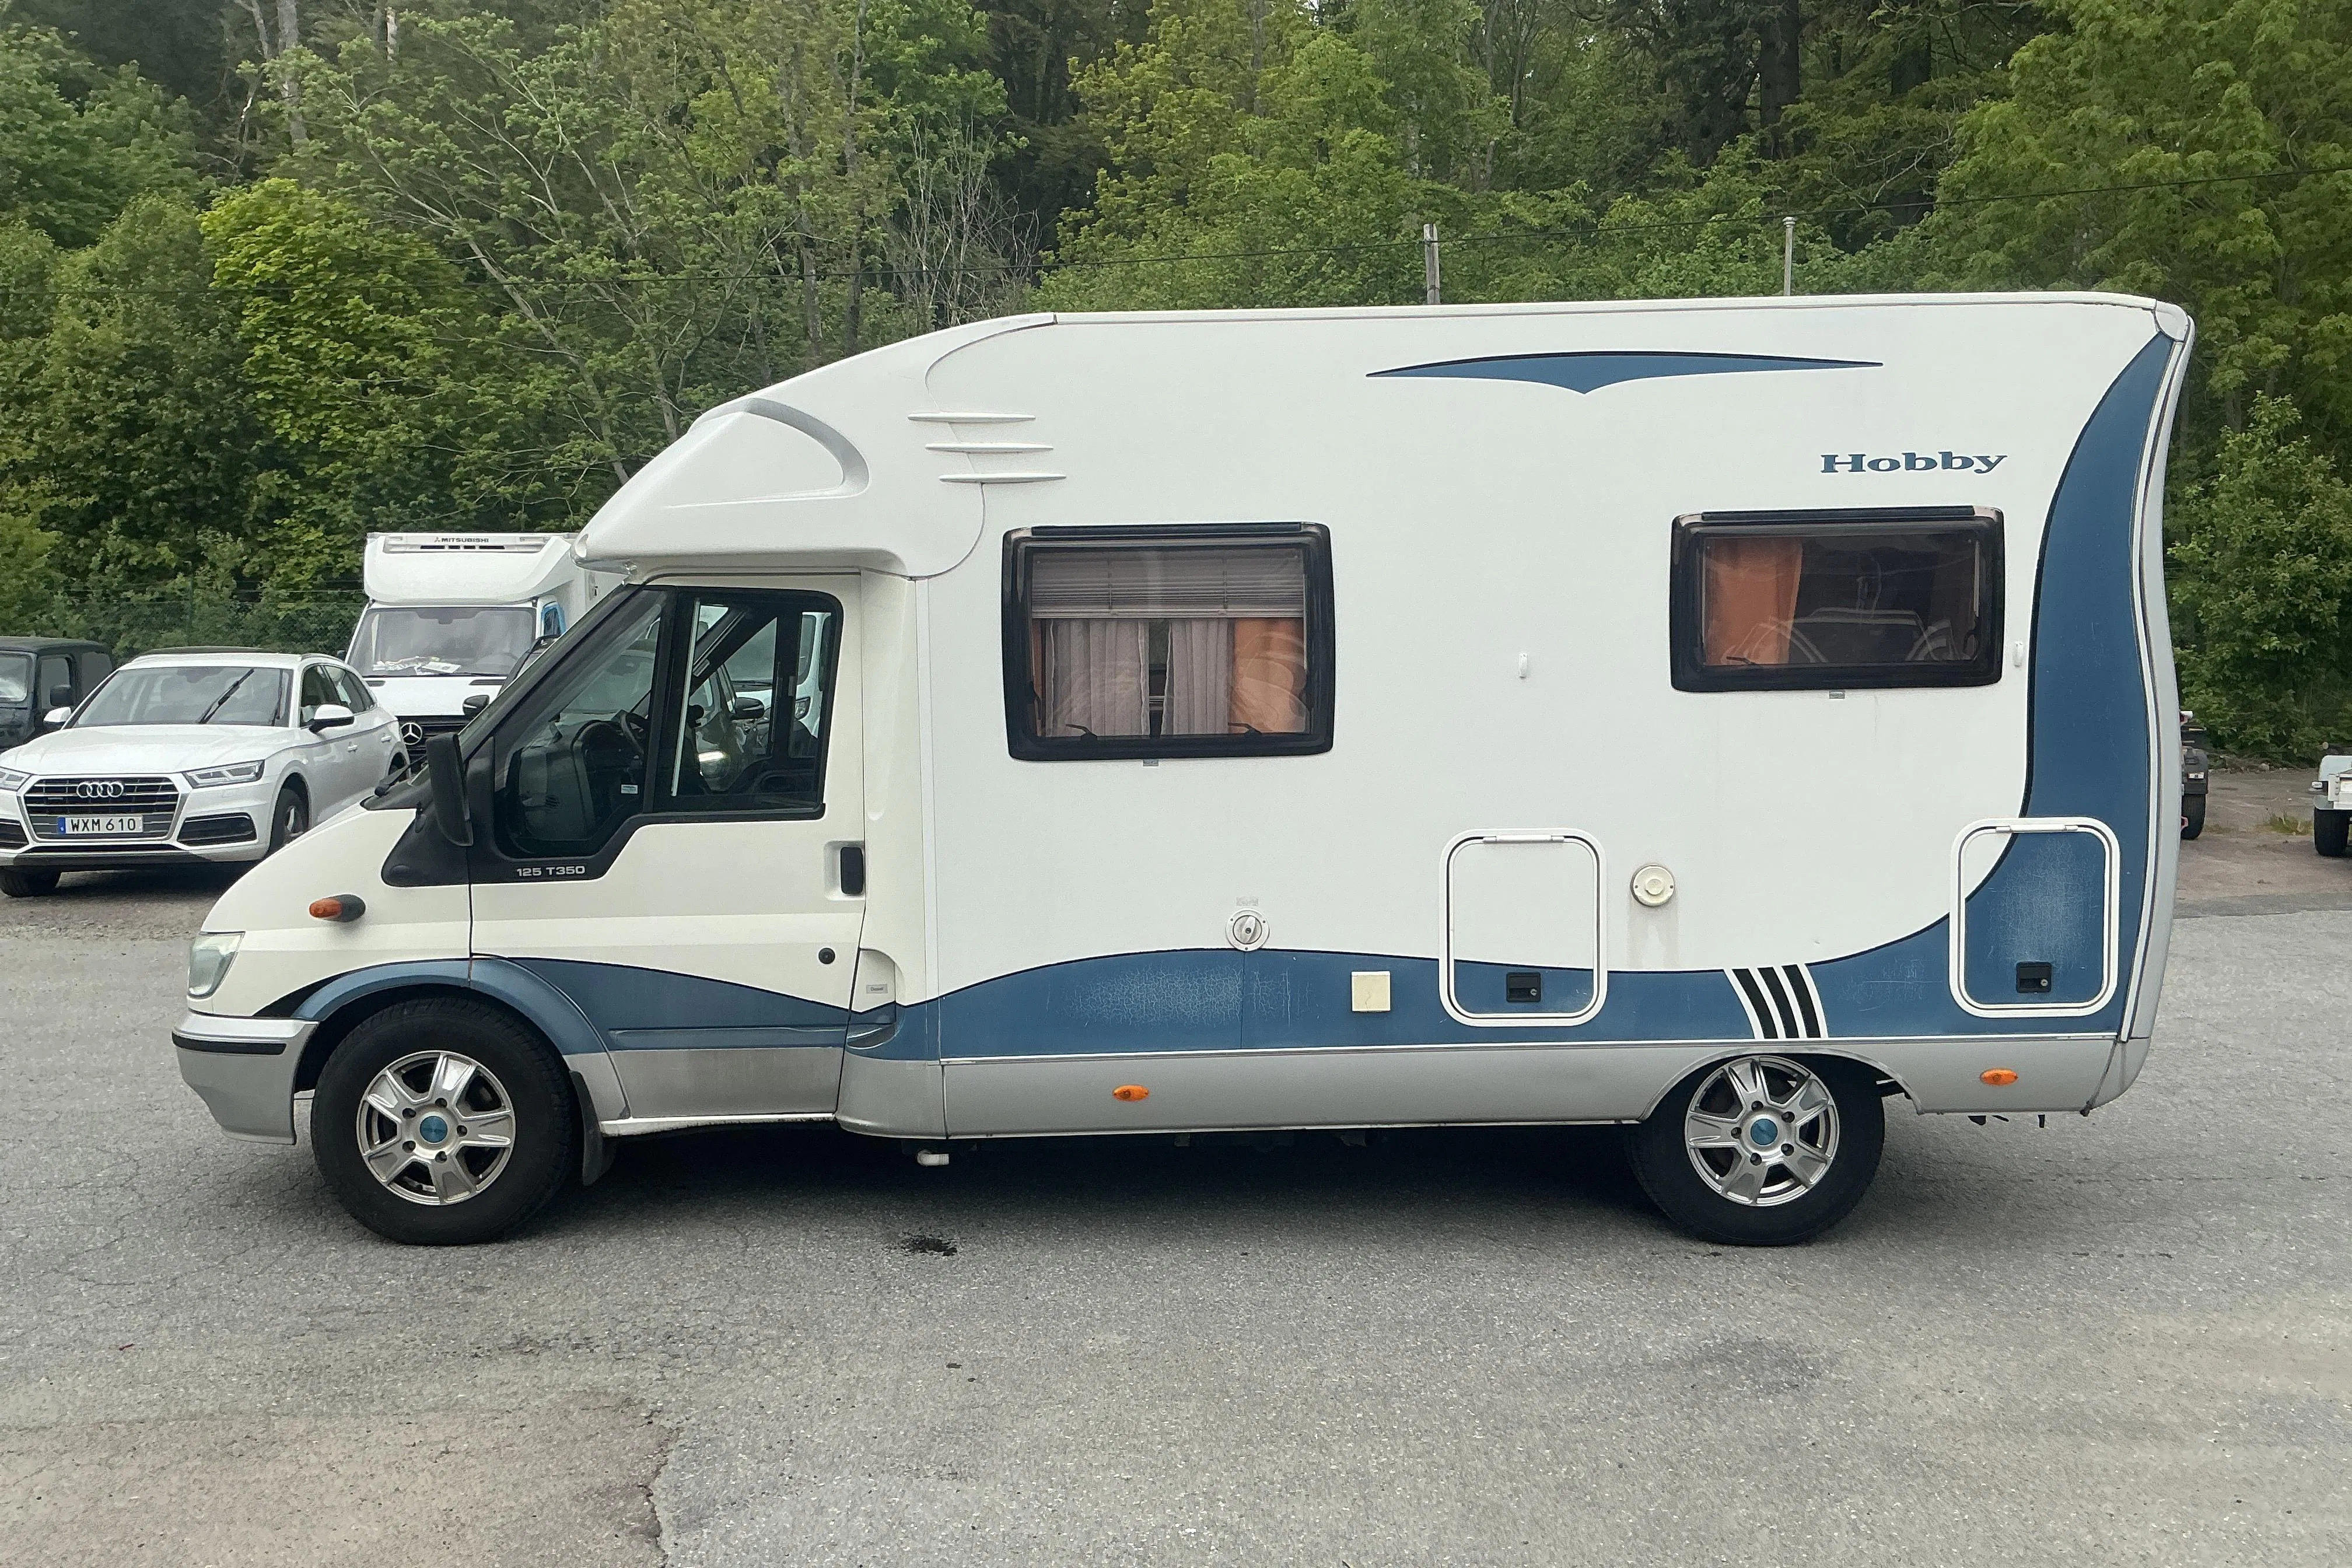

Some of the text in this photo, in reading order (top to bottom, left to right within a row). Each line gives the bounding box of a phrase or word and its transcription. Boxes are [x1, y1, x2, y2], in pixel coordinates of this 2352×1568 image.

[1821, 452, 2008, 474] Hobby
[71, 818, 135, 831] WXM 610
[516, 866, 585, 877] 125 T350
